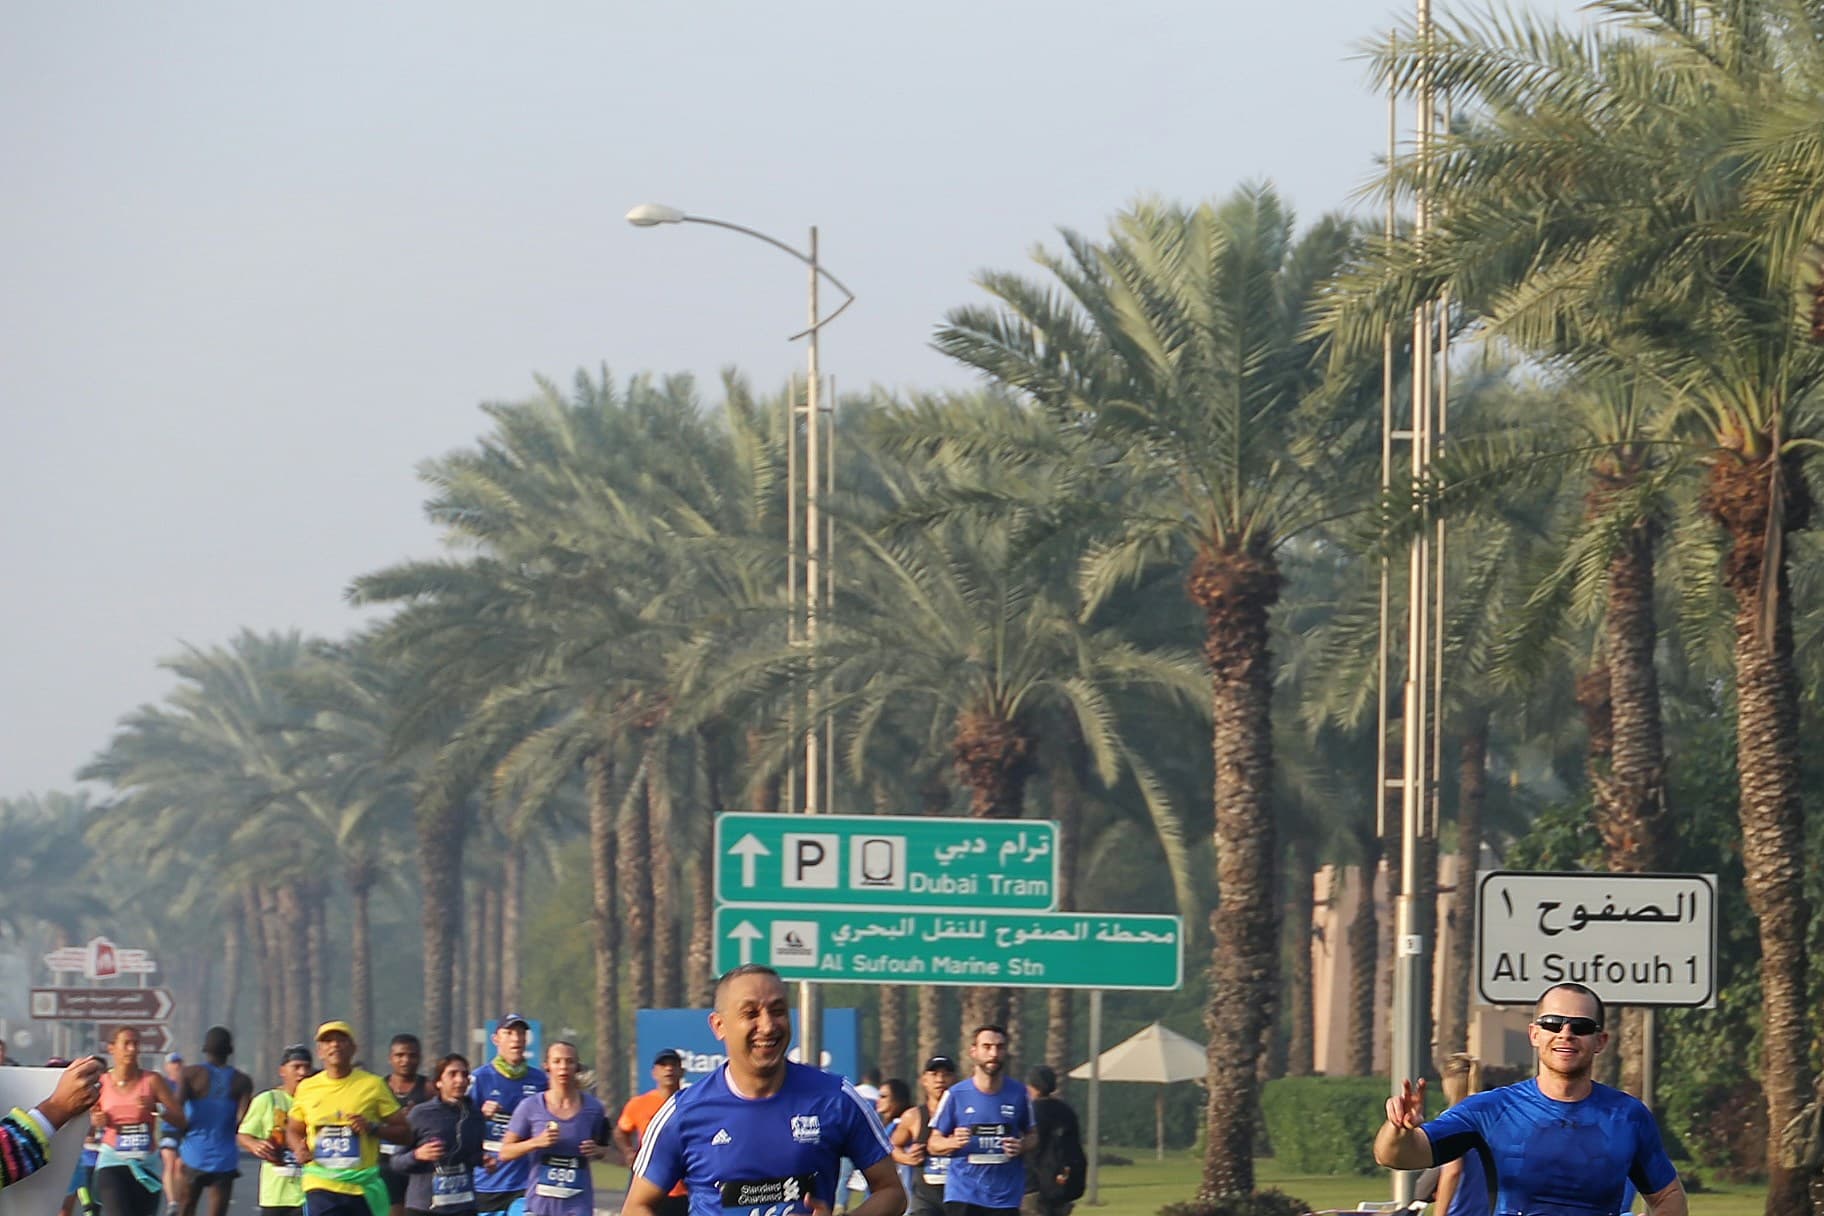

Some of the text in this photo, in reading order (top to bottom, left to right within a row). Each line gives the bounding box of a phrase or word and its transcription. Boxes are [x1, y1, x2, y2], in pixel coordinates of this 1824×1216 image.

[797, 840, 825, 882] P
[934, 831, 1050, 866] ترام دبي
[909, 873, 1049, 897] Dubai Tram
[1501, 887, 1697, 936] الصفوح ١
[831, 917, 1176, 948] محطة الصفوح للنقل البحري
[819, 953, 1045, 977] Al Sufouh Marine Stn
[1491, 952, 1697, 985] Al Sufouh 1
